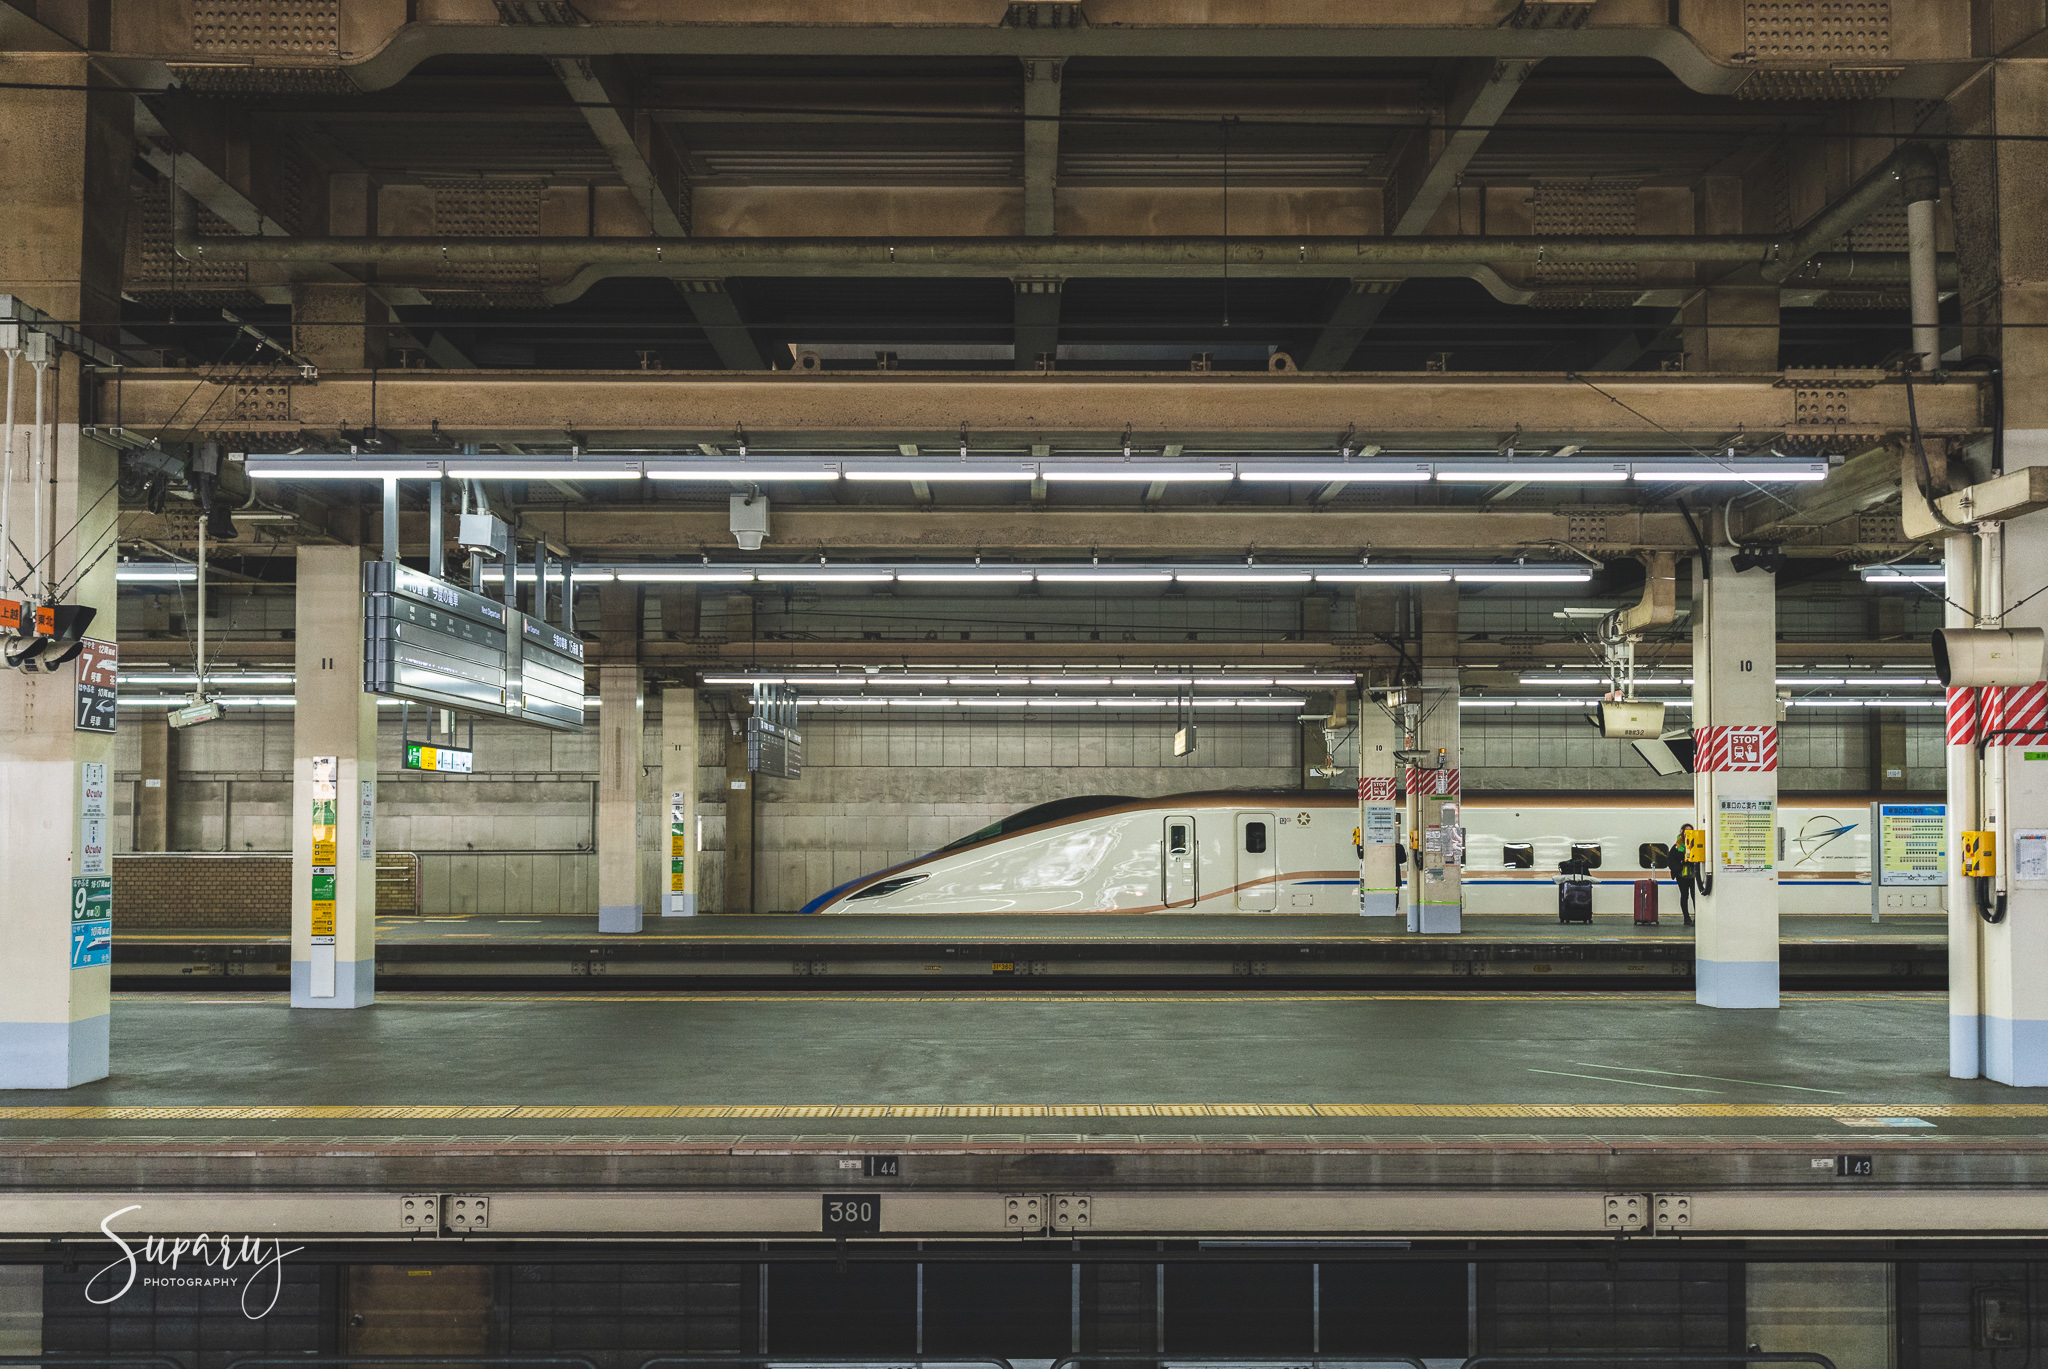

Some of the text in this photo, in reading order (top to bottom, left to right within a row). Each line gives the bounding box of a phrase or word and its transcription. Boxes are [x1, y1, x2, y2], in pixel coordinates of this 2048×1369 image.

[1, 607, 19, 621] 上越
[38, 614, 53, 627] 東北
[1740, 660, 1753, 672] 10
[1732, 735, 1759, 745] STOP
[74, 887, 87, 919] 9
[73, 935, 85, 965] 7
[881, 1161, 897, 1175] 44
[1854, 1161, 1871, 1175] 43
[829, 1201, 872, 1222] 380
